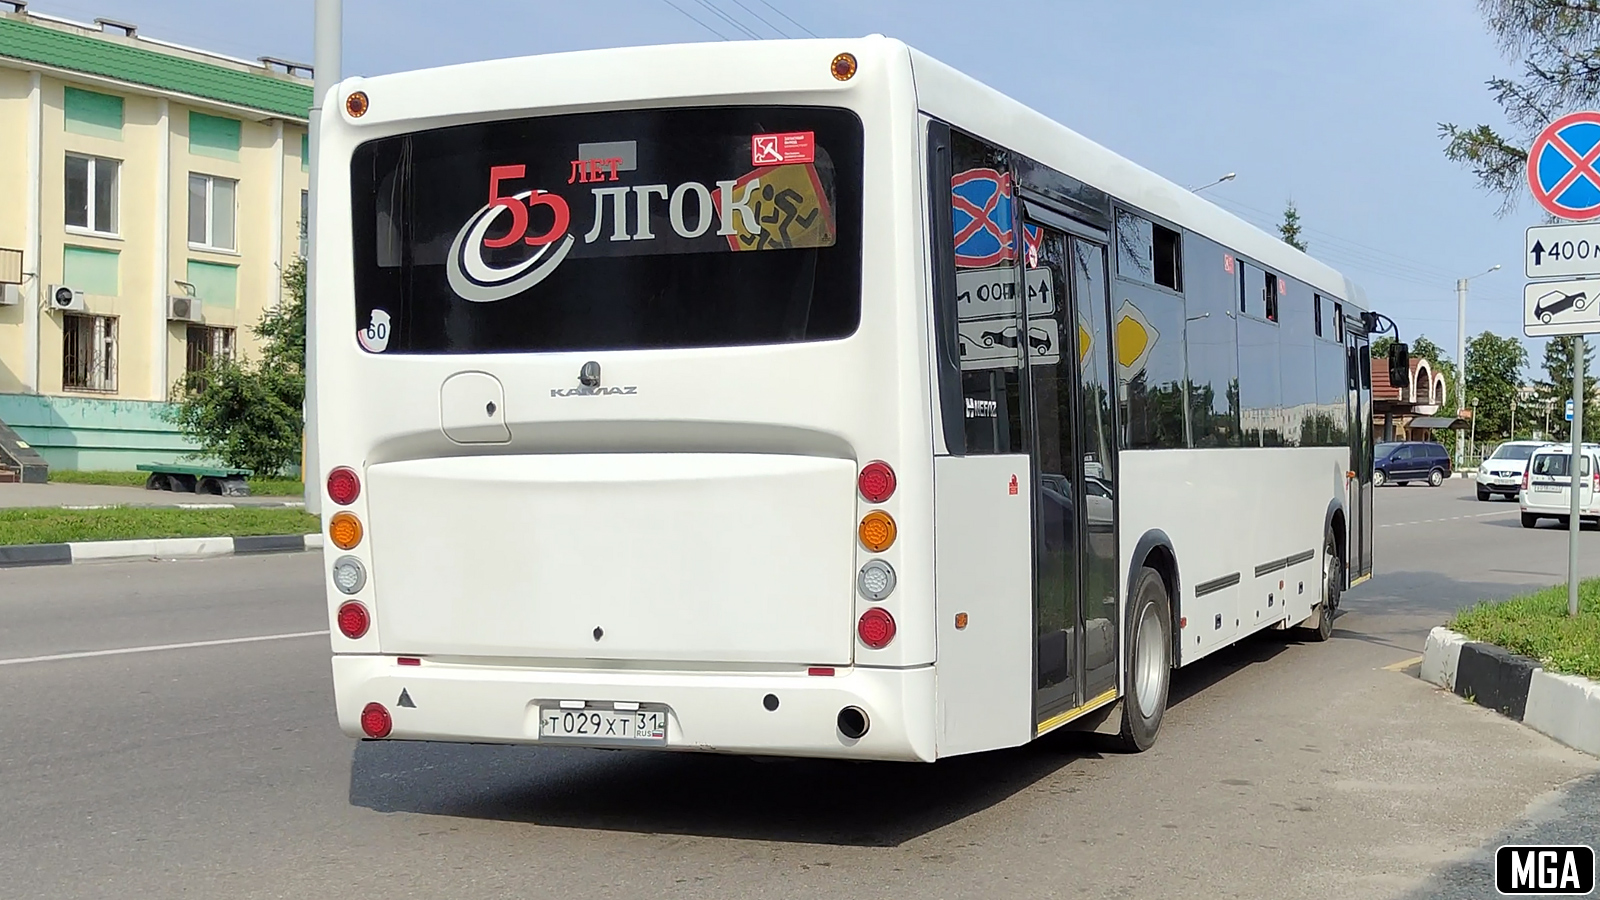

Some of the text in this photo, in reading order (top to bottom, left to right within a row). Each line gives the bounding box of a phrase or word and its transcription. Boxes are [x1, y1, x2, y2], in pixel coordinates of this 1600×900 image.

[567, 157, 623, 184] ЛЕТ
[483, 163, 571, 248] 55
[584, 177, 762, 244] ЛГОК
[1548, 240, 1590, 261] 400
[367, 323, 386, 340] 60
[637, 713, 657, 731] 31
[636, 730, 652, 738] RUS
